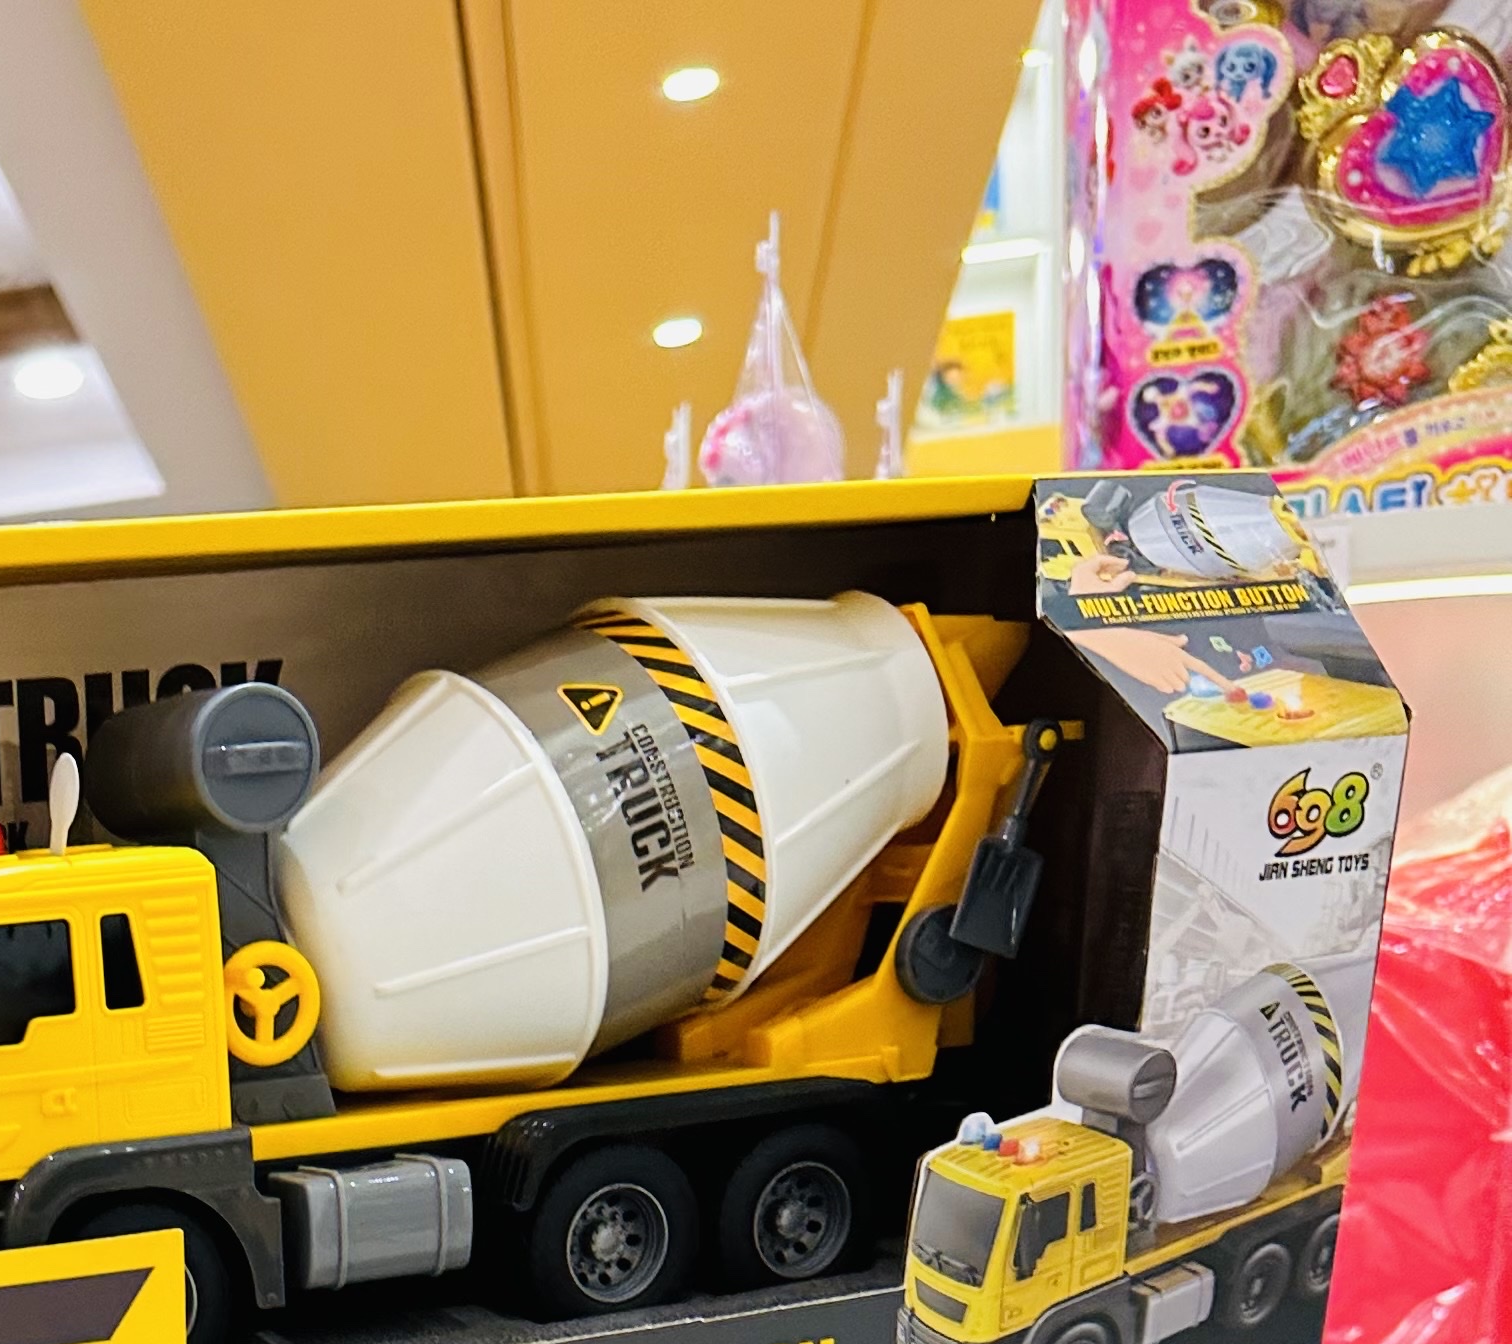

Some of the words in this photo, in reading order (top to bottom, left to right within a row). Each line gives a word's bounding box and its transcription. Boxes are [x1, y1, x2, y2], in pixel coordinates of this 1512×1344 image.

[1077, 590, 1235, 619] MULTI-FUNCTION
[1234, 583, 1311, 608] BUTTON
[595, 731, 679, 893] TRUCK
[630, 723, 696, 871] CONSTRUCTION
[1267, 766, 1370, 858] 698
[1259, 861, 1289, 881] JIAN
[1291, 856, 1335, 878] SHENG
[1337, 853, 1370, 875] TOYS
[1267, 1017, 1308, 1113] TRUCK
